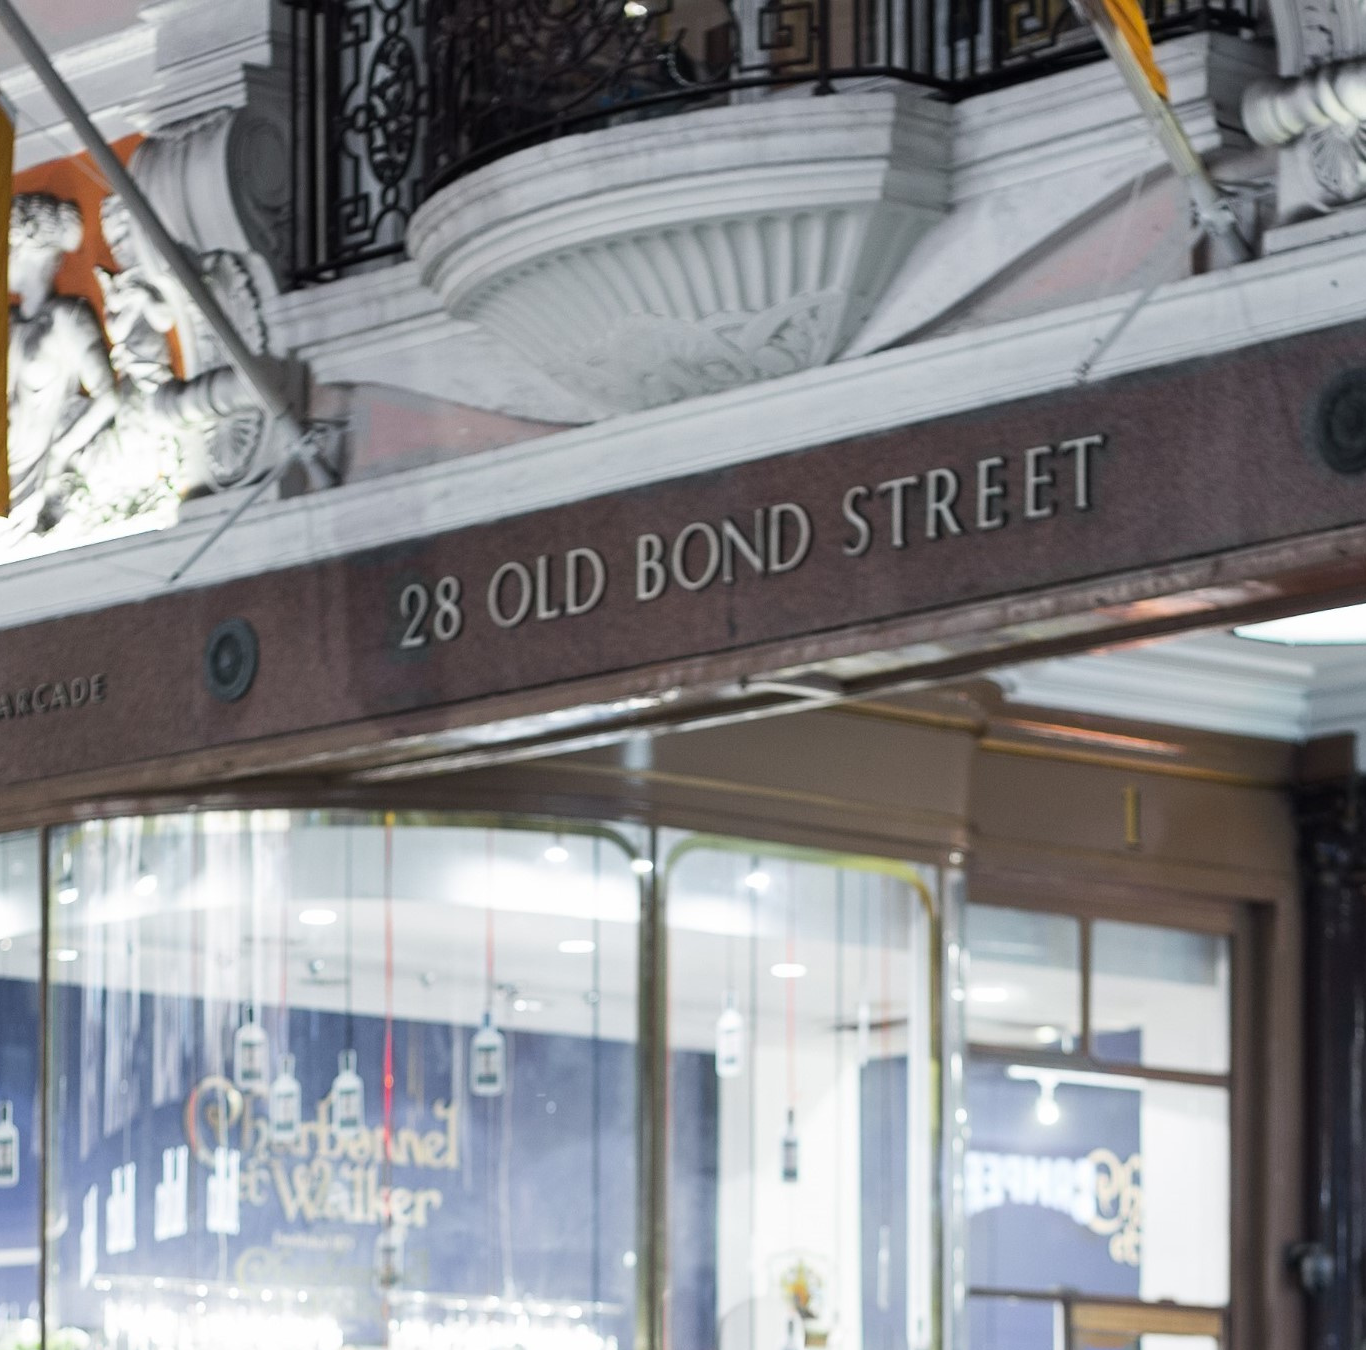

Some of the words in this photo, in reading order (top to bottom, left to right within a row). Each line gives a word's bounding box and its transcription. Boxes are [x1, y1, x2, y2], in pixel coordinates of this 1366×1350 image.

[399, 575, 463, 650] 28
[487, 547, 607, 629] OLD
[636, 502, 813, 602] BOND
[842, 434, 1104, 557] STREET
[183, 1074, 461, 1169] Chrbonnel
